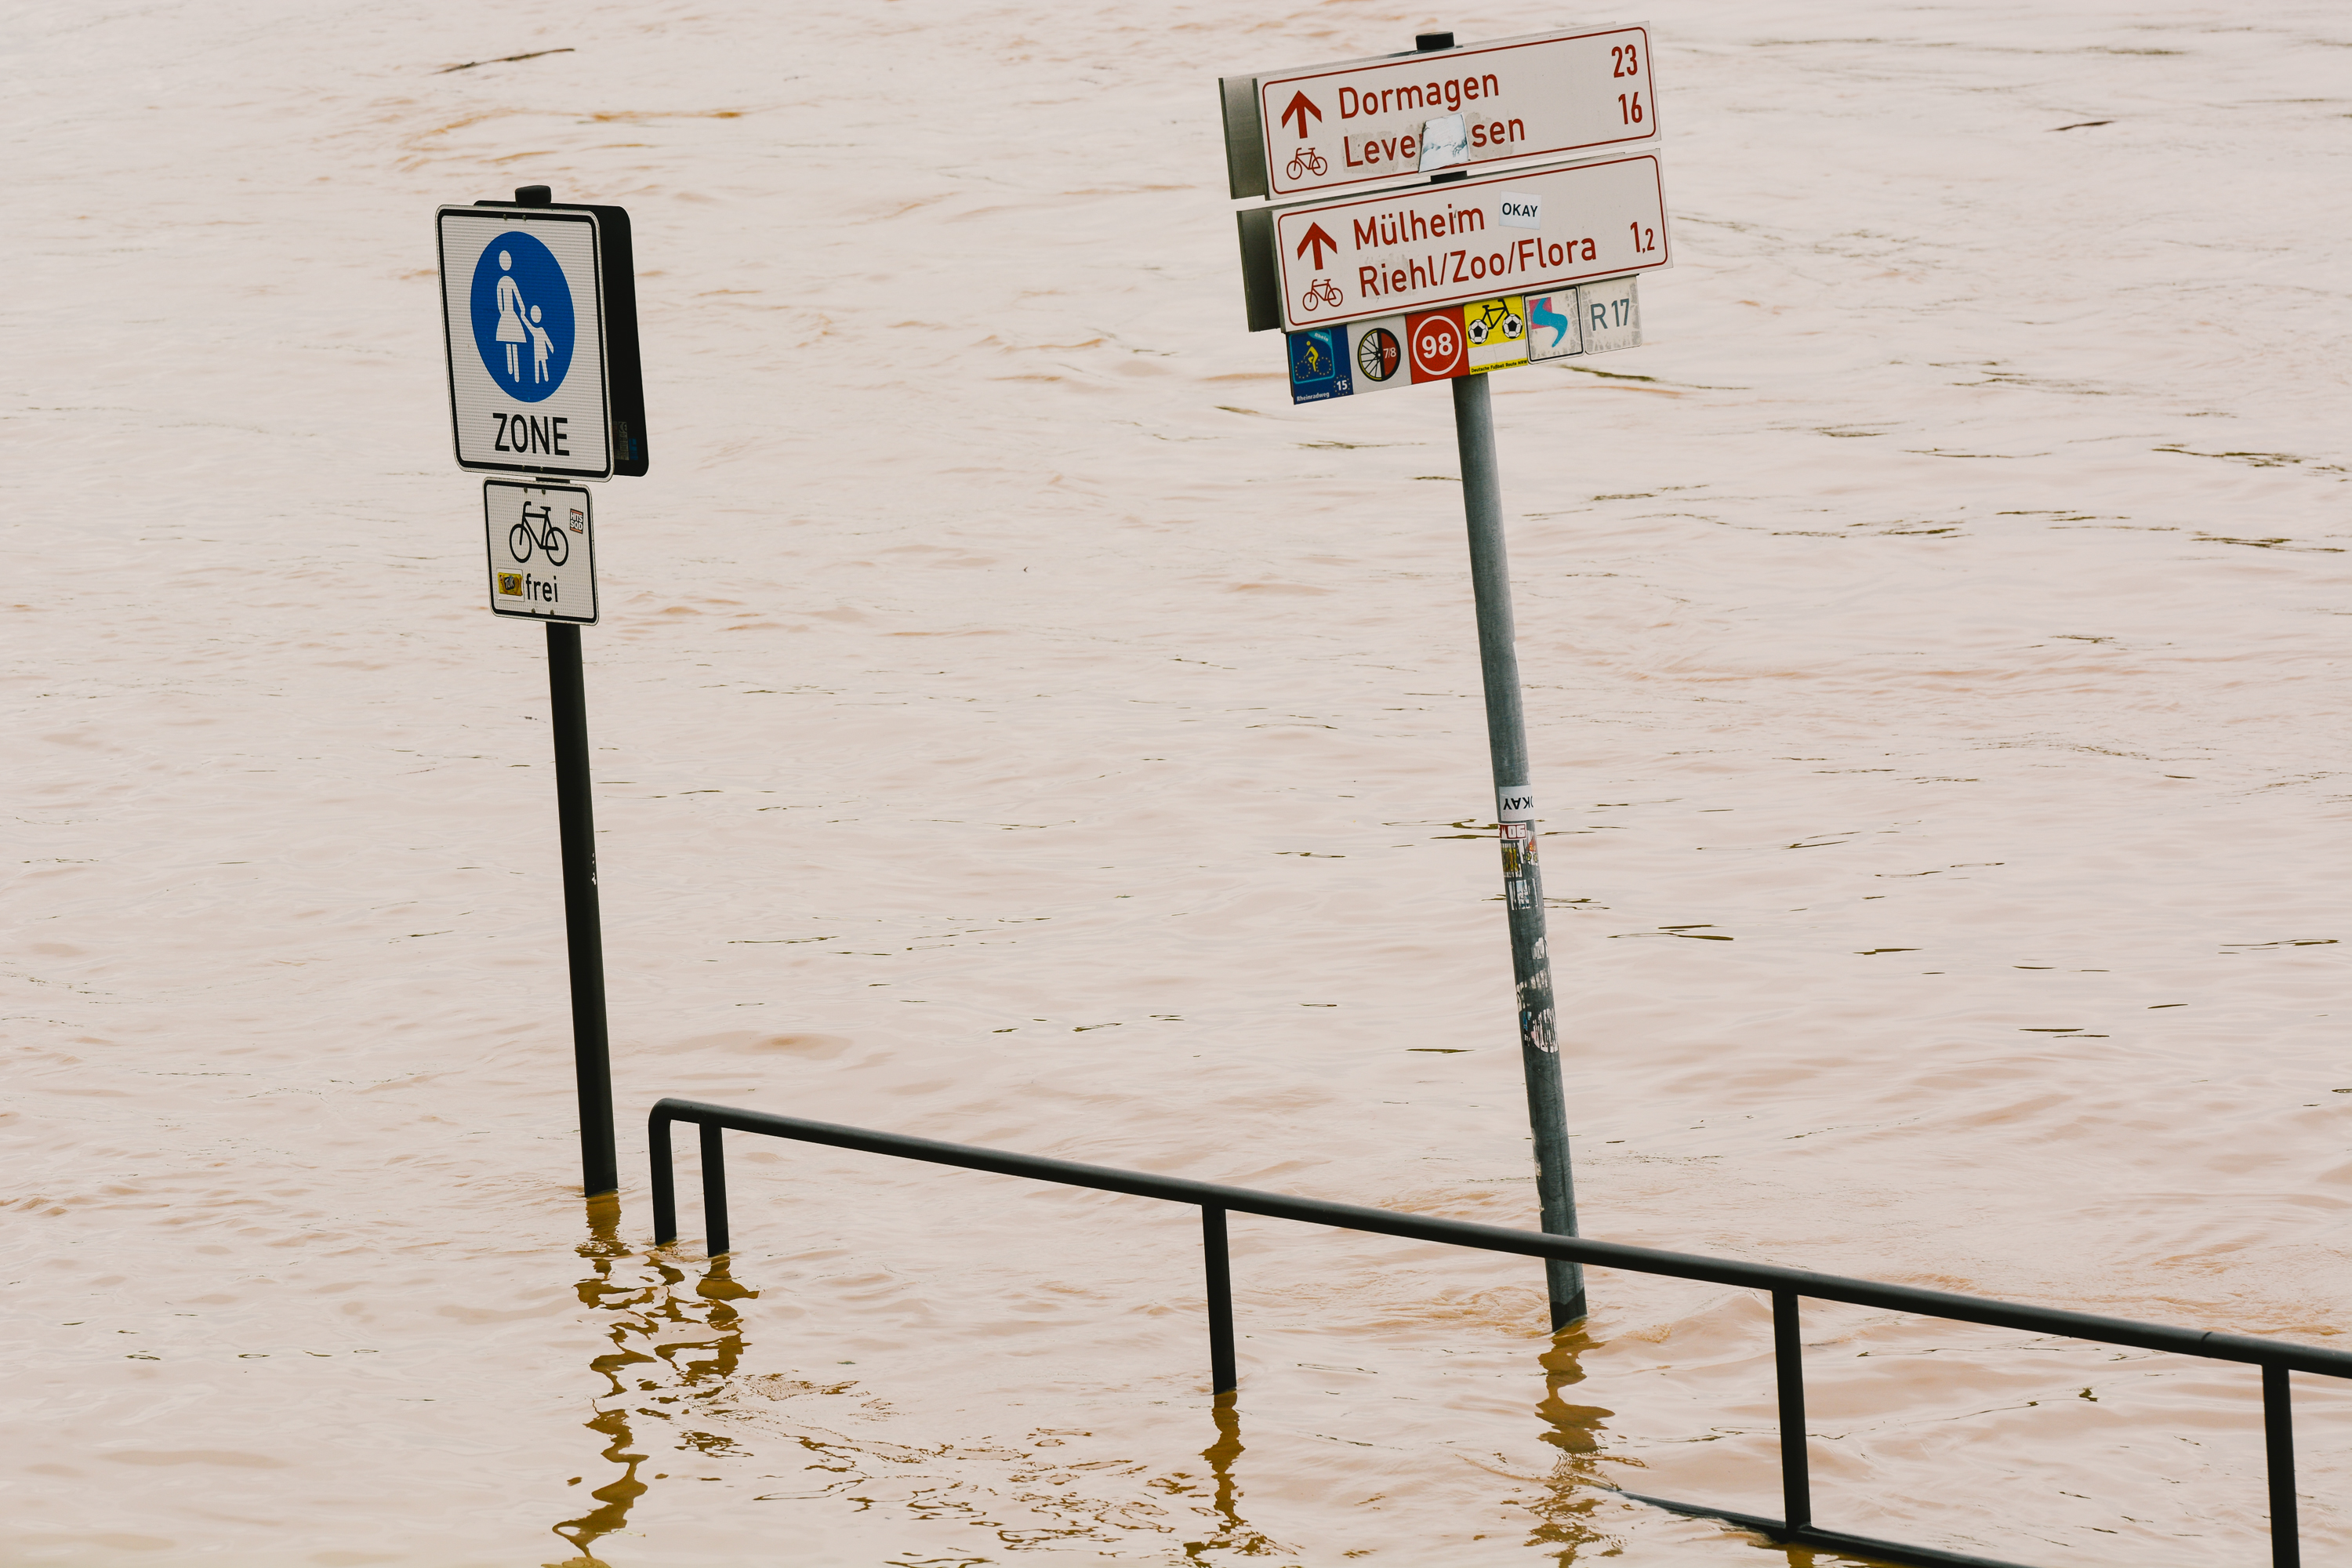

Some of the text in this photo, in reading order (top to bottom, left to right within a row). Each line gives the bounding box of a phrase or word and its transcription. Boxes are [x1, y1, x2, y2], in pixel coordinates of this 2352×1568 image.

[1338, 44, 1639, 119] Dormagen 23
[1344, 91, 1643, 167] Levesen 16
[1502, 202, 1538, 218] OKAY
[1353, 203, 1485, 250] Mülheim
[1359, 221, 1655, 297] Riehl/Zoo/Flora 1,2
[1590, 298, 1630, 332] R 17
[1314, 332, 1329, 342] Rhein
[1421, 332, 1453, 359] 98
[1383, 347, 1396, 359] 7/8
[1296, 392, 1330, 402] Rheinradweg
[1336, 379, 1348, 391] 15
[492, 412, 570, 456] ZONE
[570, 511, 583, 523] HITS
[570, 519, 583, 531] SQD
[525, 572, 558, 603] frei
